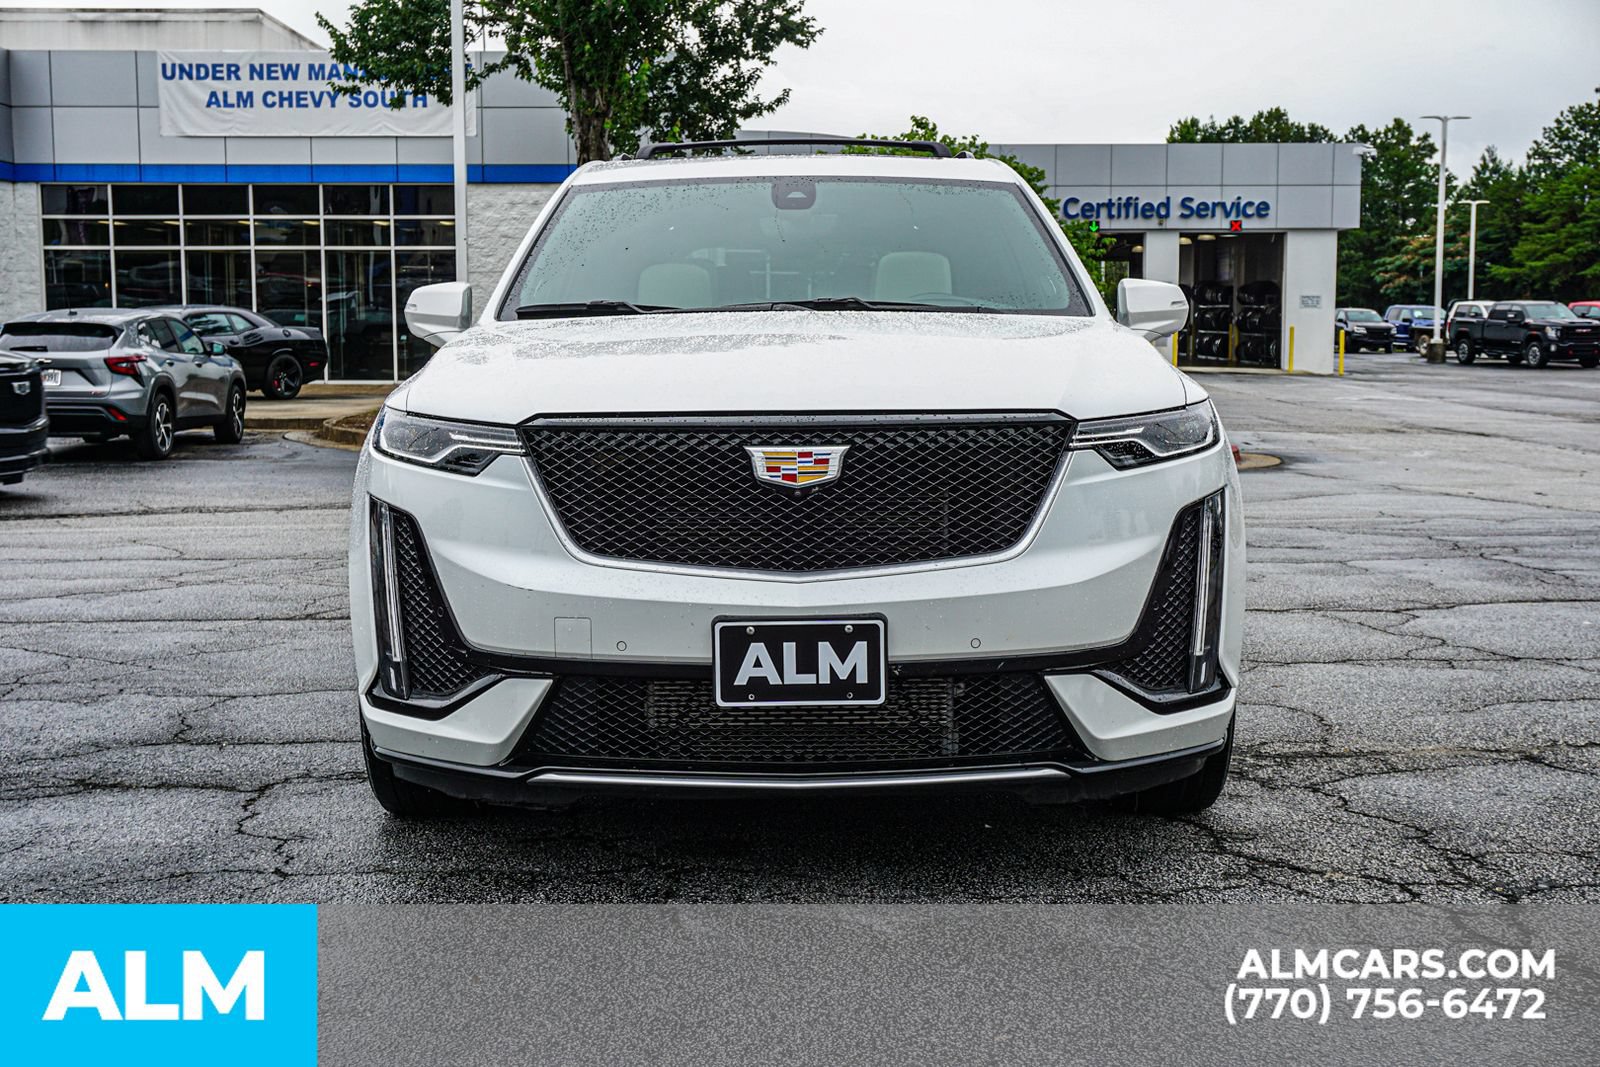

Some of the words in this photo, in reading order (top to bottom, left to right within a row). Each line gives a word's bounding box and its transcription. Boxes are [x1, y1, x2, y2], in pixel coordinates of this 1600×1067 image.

[161, 62, 241, 81] UNDER
[249, 63, 300, 81] NEW
[205, 90, 254, 108] ALM
[261, 90, 341, 109] CHEVY
[1063, 196, 1171, 220] Certified
[1179, 196, 1271, 219] Service
[733, 641, 868, 685] ALM
